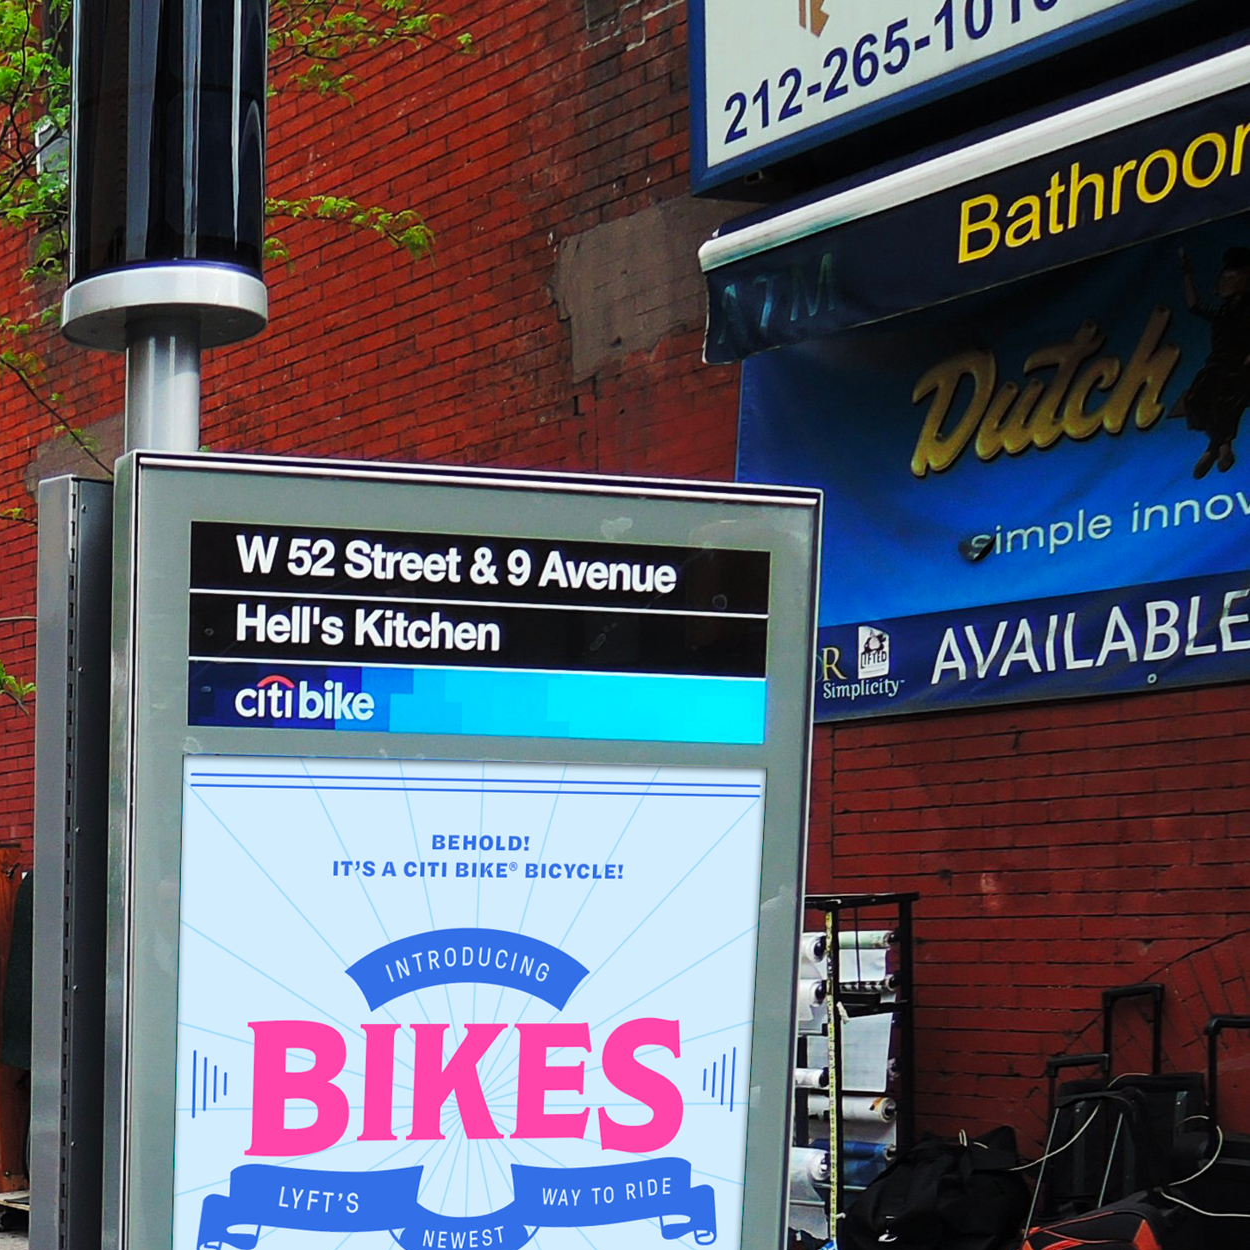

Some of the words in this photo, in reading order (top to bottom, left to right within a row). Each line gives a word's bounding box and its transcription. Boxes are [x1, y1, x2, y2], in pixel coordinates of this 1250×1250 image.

[911, 305, 1181, 476] Dutch
[236, 536, 279, 574] W
[287, 538, 335, 577] 52
[344, 540, 462, 585] Street
[468, 548, 498, 586] &
[506, 549, 531, 587] 9
[538, 552, 677, 594] Avenue
[236, 604, 343, 646] Hell's
[354, 609, 500, 652] Kitchen
[860, 650, 887, 670] LIFTED
[431, 834, 530, 851] BEHOLD!
[381, 861, 397, 877] A
[403, 861, 447, 878] CITI
[524, 863, 624, 880] BICYCLE!
[384, 946, 550, 983] INTRODUCING
[243, 1016, 684, 1157] BIKES
[422, 1225, 506, 1249] NEWEST
[541, 1187, 582, 1207] WAY
[591, 1185, 615, 1204] TO
[625, 1177, 673, 1199] RIDE
